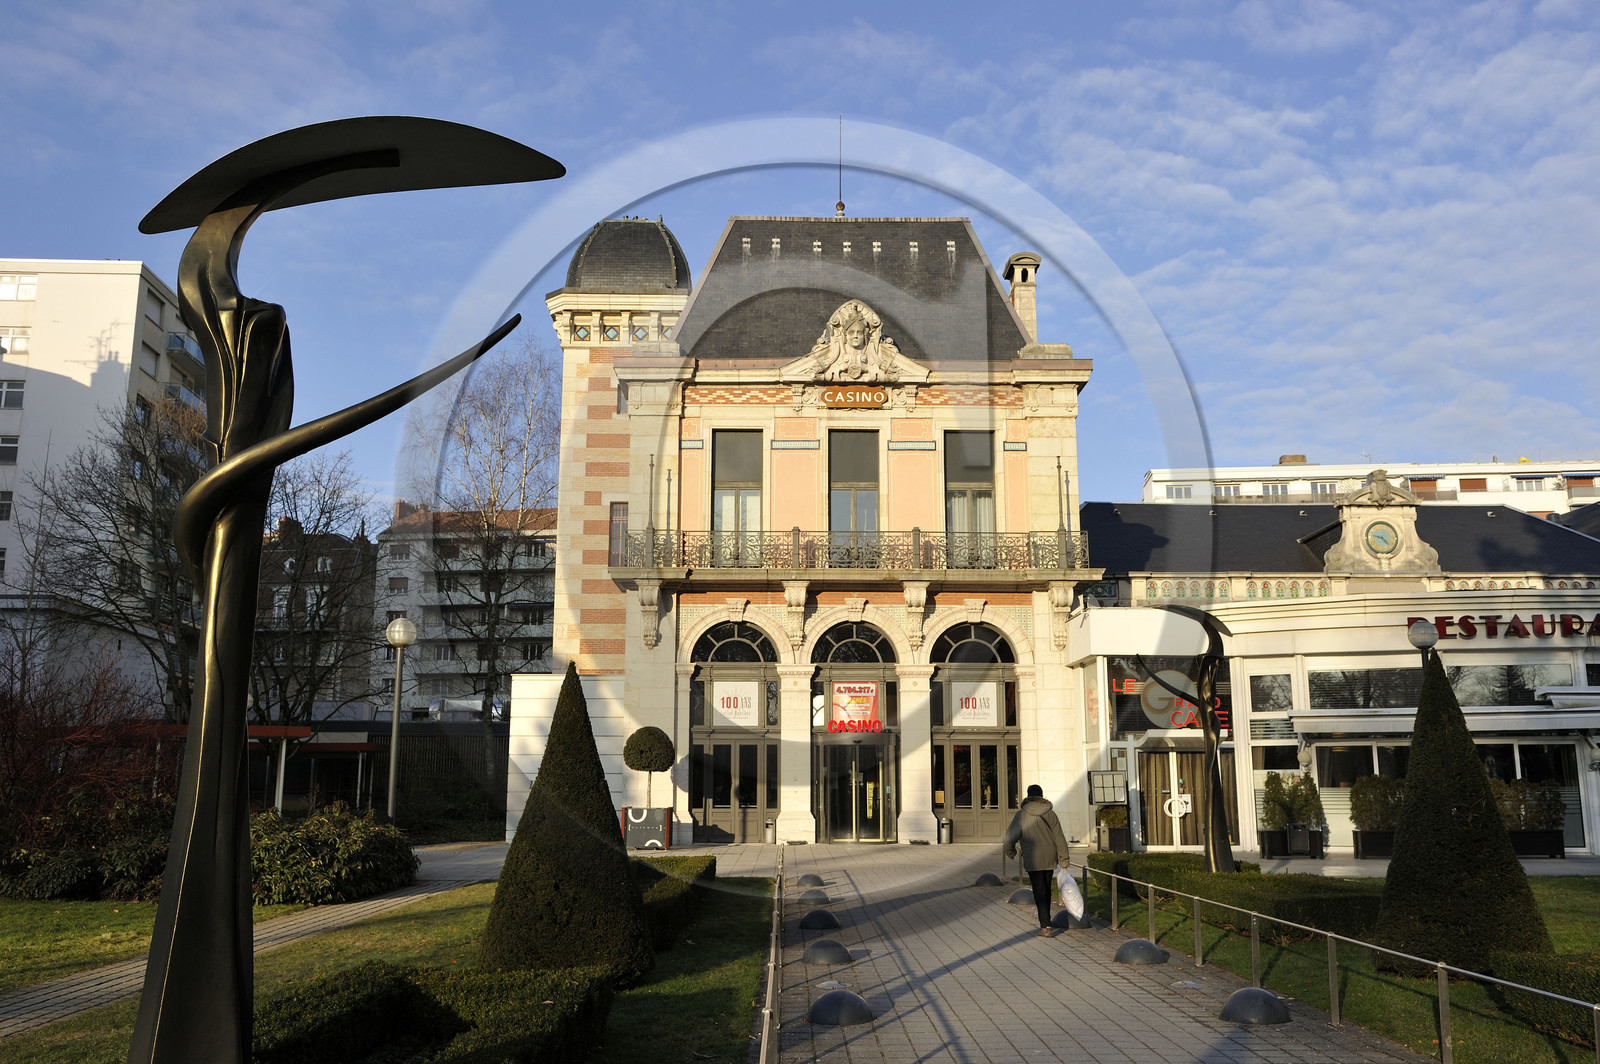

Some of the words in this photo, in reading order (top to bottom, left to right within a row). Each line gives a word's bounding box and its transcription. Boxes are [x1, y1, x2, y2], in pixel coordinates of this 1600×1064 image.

[824, 391, 885, 403] CASINO
[1113, 679, 1136, 692] LE
[721, 696, 739, 709] 100
[740, 697, 752, 709] ANS
[959, 697, 977, 709] 100
[978, 697, 991, 709] ANS
[1171, 711, 1229, 727] CAE
[827, 720, 883, 733] CASINO
